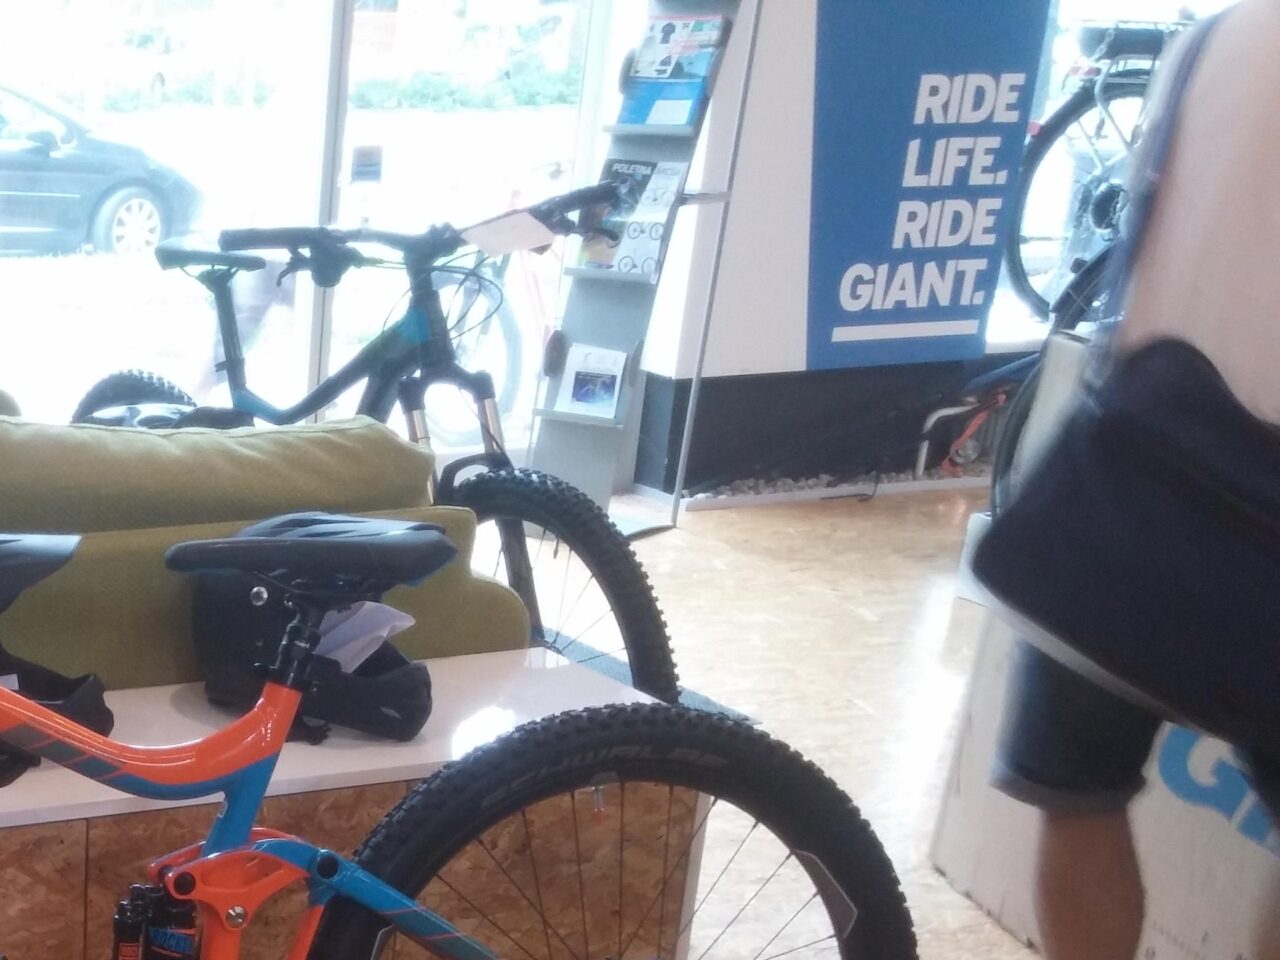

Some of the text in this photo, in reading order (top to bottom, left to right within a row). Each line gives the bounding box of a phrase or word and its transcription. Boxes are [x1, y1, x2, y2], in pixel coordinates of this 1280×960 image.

[913, 73, 1026, 125] RIDE
[902, 136, 1009, 188] LIFE.
[892, 198, 1003, 250] RIDE
[839, 258, 988, 312] GIANT.
